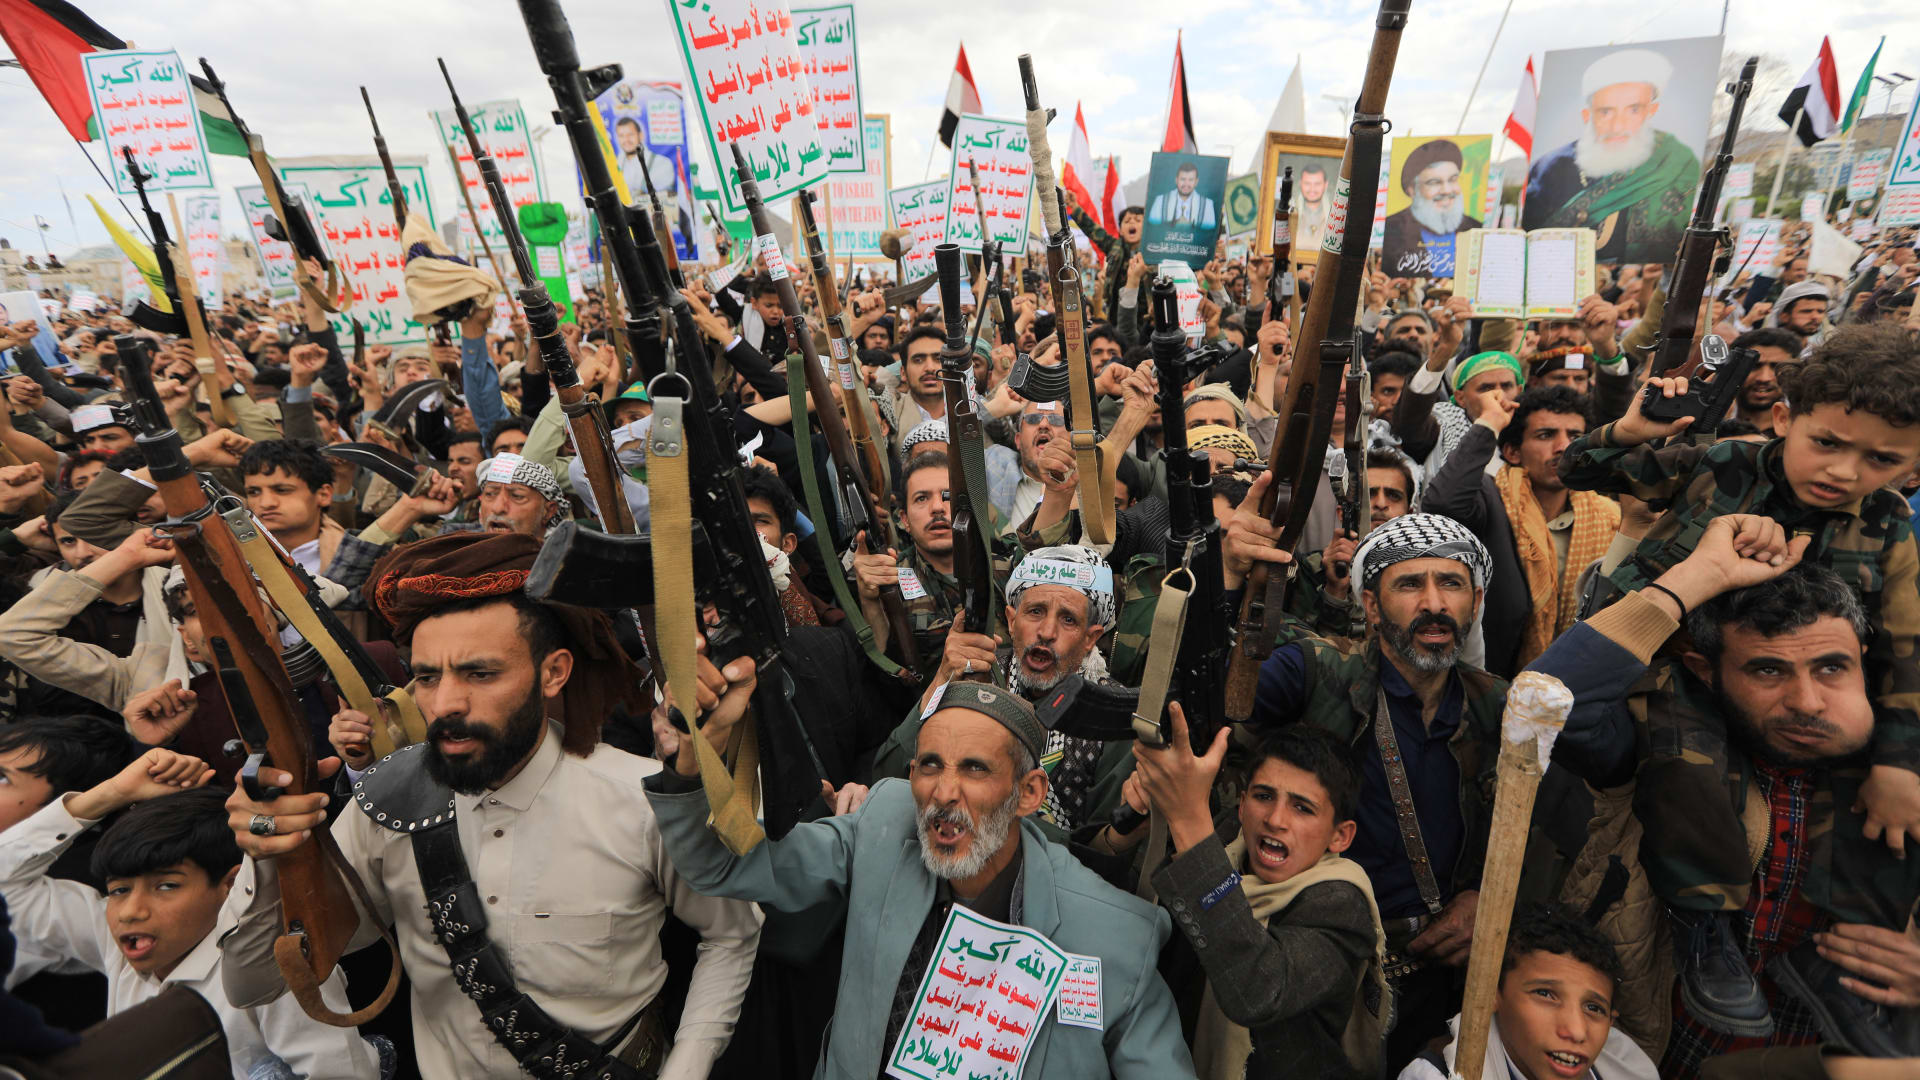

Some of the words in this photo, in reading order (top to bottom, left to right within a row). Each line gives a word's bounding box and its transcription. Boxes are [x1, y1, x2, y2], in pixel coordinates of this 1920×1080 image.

[688, 2, 762, 50] لأمريكا
[797, 15, 821, 46] أك
[825, 17, 851, 43] الله
[97, 58, 143, 92] أكبر
[150, 61, 182, 81] الله
[706, 47, 774, 104] لإسرائيل
[822, 54, 852, 77] الموت
[824, 84, 854, 106] الموت
[494, 108, 522, 132] الله
[717, 104, 766, 143] اليهود
[771, 98, 791, 133] على
[834, 112, 857, 128] اللعنة
[827, 136, 859, 165] النصر
[960, 125, 1006, 153] أكبر
[165, 156, 204, 183] النصر
[898, 189, 925, 215] أكبر
[859, 231, 881, 249] ISLA
[1059, 563, 1077, 580] علم
[947, 935, 1021, 964] أكبر
[938, 957, 998, 990] لأمريكا
[1015, 948, 1057, 988] الله
[1084, 963, 1098, 974] الله
[926, 986, 987, 1021] لإسرائيل
[998, 980, 1042, 1016] الموت
[917, 1011, 960, 1039] اليهود
[987, 1007, 1032, 1042] الموت
[1062, 1006, 1081, 1020] للإسلام
[1083, 1008, 1100, 1020] النصر
[958, 1031, 984, 1052] على
[987, 1037, 1022, 1068] اللعنة
[903, 1035, 963, 1079] للإسلام
